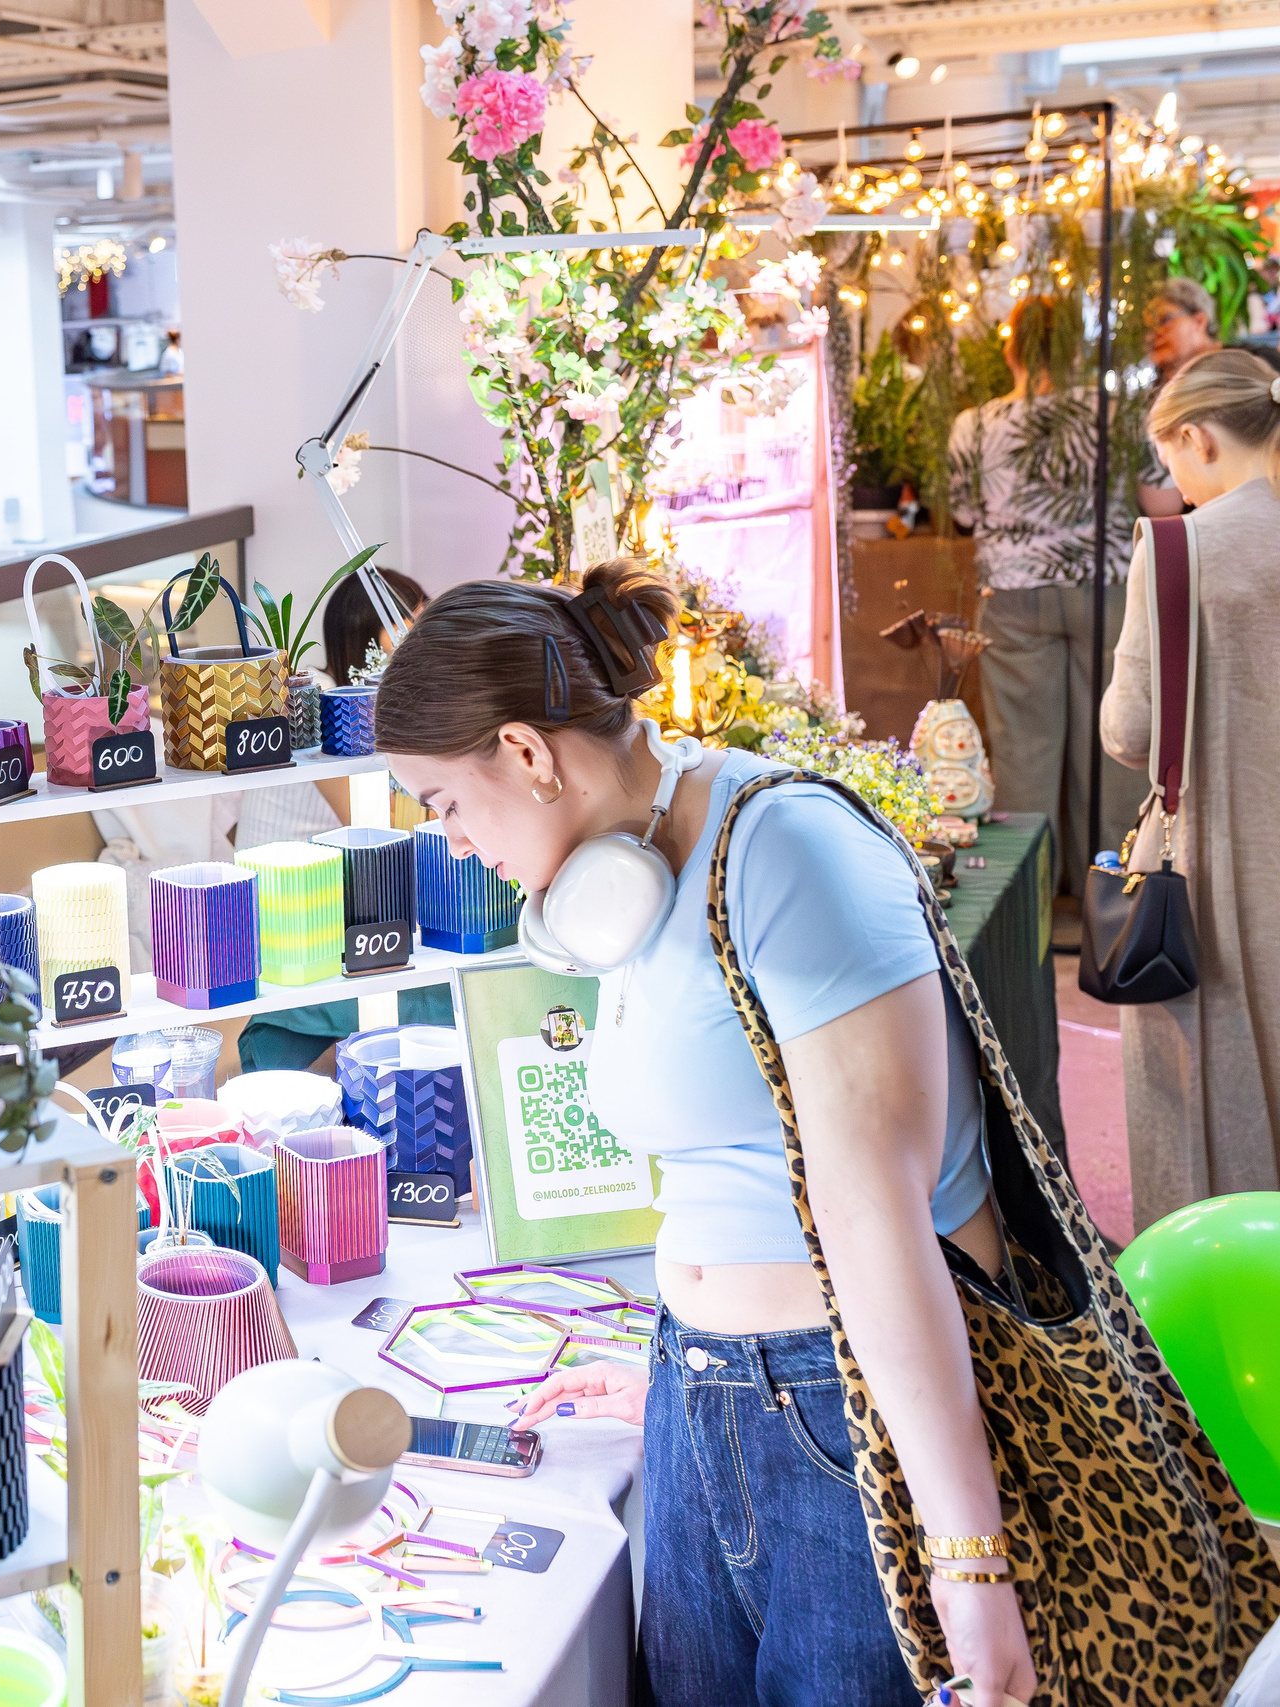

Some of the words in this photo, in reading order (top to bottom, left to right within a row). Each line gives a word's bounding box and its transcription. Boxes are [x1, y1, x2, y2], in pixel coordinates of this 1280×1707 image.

[236, 727, 283, 756] 800
[98, 745, 144, 771] 600
[355, 931, 401, 956] 900
[61, 979, 115, 1010] 750
[391, 1182, 449, 1203] 1300
[533, 1182, 636, 1202] @MOLODO_ZELENO2025
[367, 1304, 402, 1327] 150
[497, 1531, 537, 1565] 150
